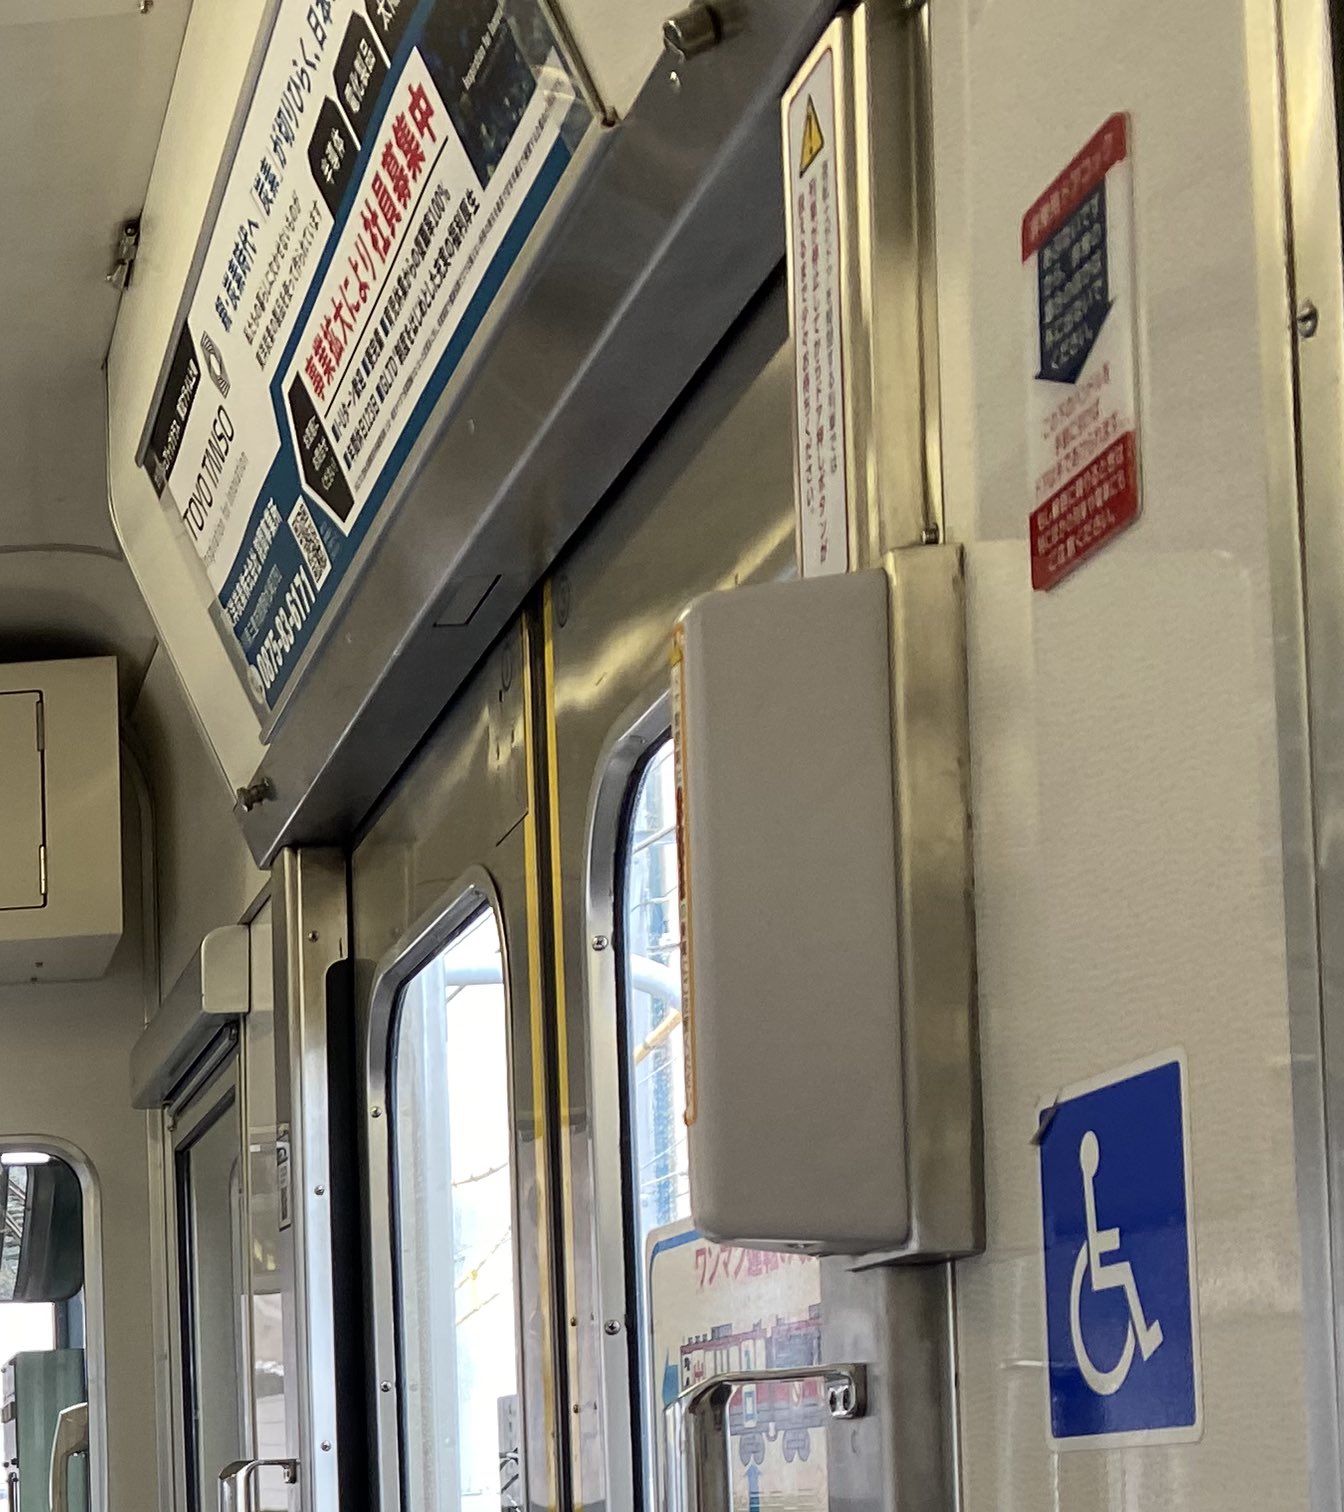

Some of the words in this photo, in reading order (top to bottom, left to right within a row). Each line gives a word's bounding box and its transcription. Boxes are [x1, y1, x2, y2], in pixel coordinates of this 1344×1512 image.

[304, 232, 377, 401] 事業拡大により
[360, 82, 436, 264] 社員募集中
[181, 472, 213, 541] TOYO
[201, 404, 234, 488] TANSO
[256, 564, 315, 689] 0875-83-6171
